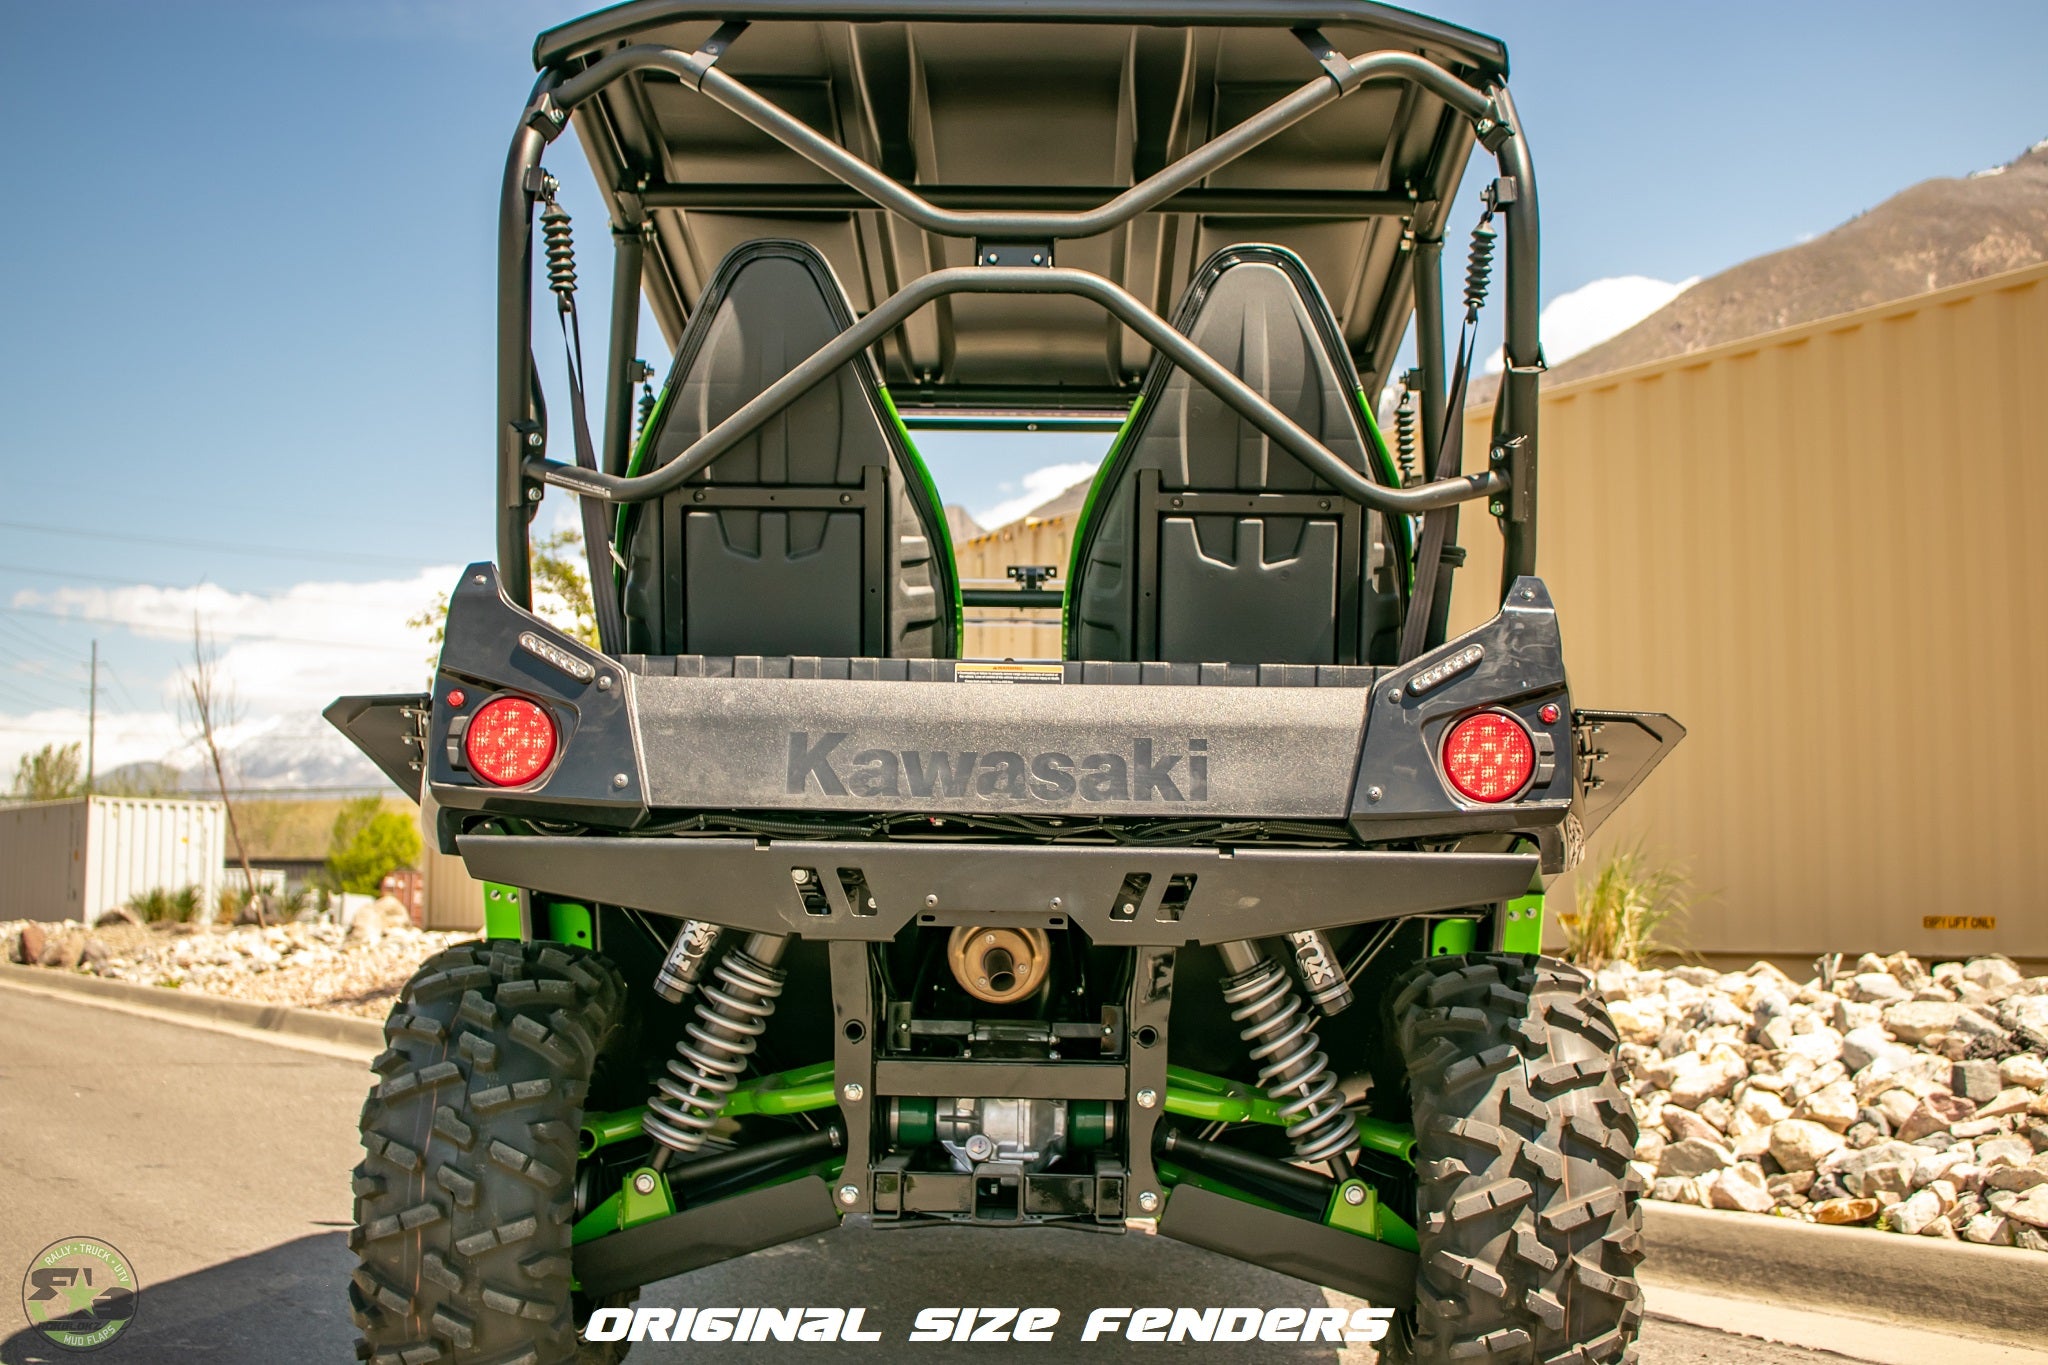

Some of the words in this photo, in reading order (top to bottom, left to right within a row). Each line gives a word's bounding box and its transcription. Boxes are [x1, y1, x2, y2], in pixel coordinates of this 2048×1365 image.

[786, 732, 1208, 801] Kawasaki
[669, 920, 717, 972] FOX
[1293, 930, 1335, 985] FOX
